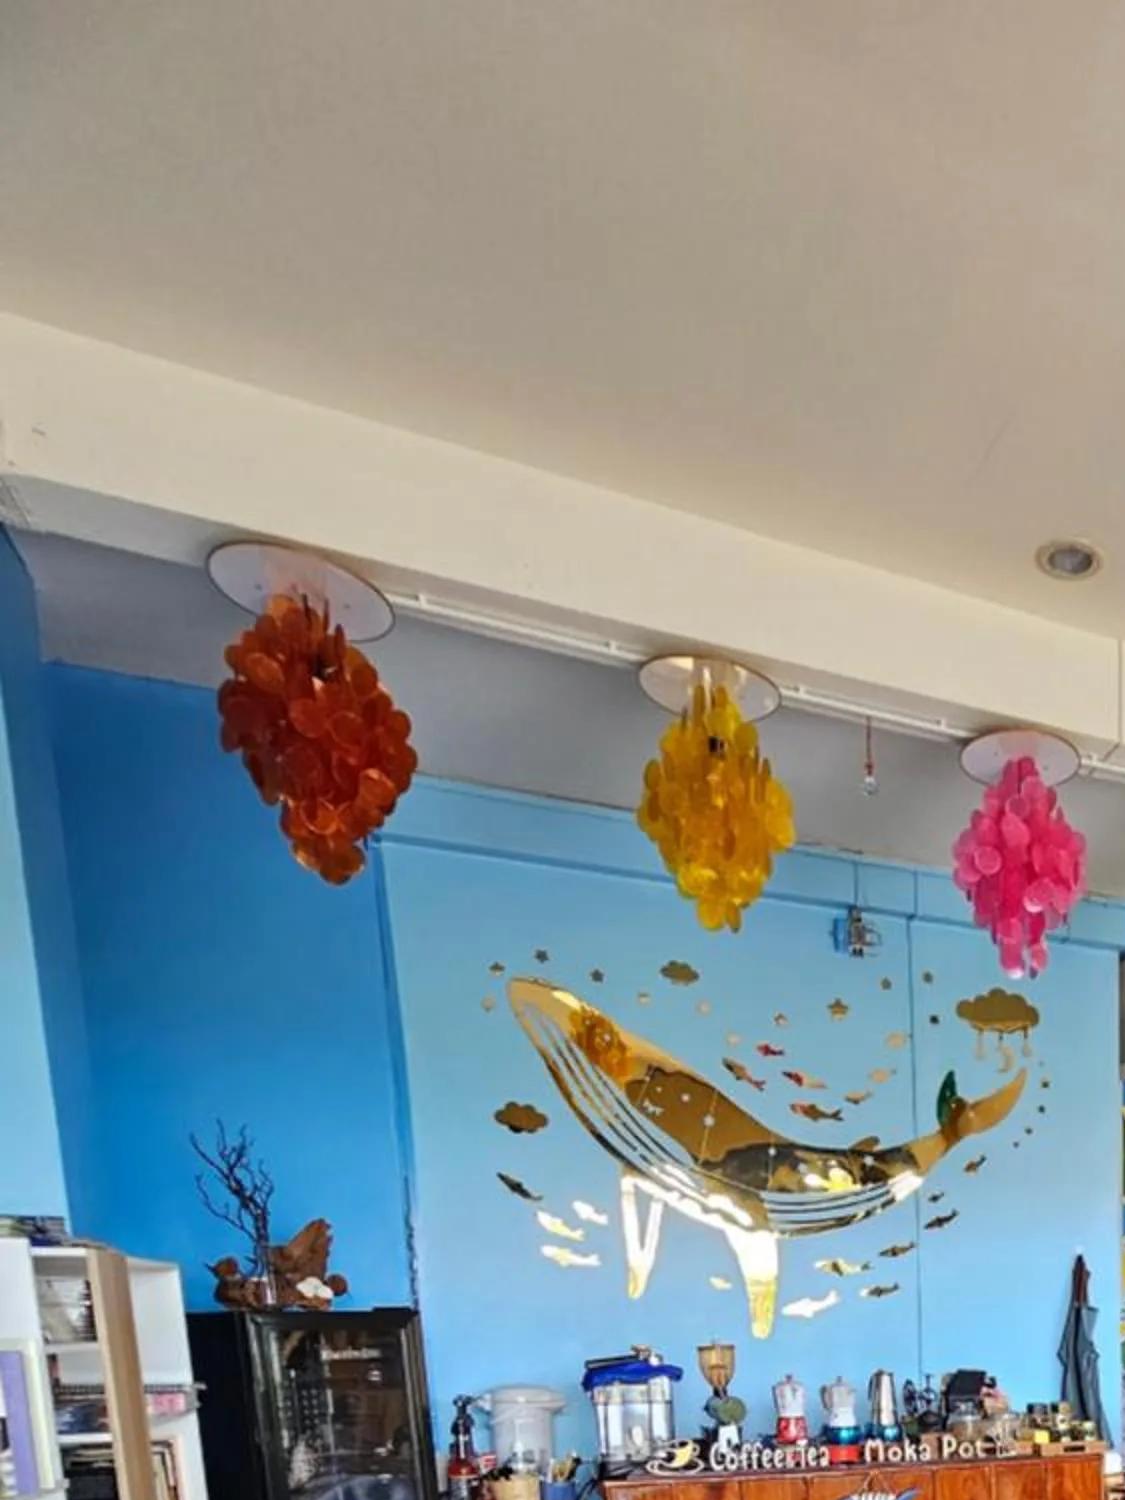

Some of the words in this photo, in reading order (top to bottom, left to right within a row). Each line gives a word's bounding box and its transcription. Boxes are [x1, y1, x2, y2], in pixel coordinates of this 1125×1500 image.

[709, 1440, 784, 1471] Coffee
[864, 1437, 932, 1463] Moka
[941, 1433, 987, 1459] Pot
